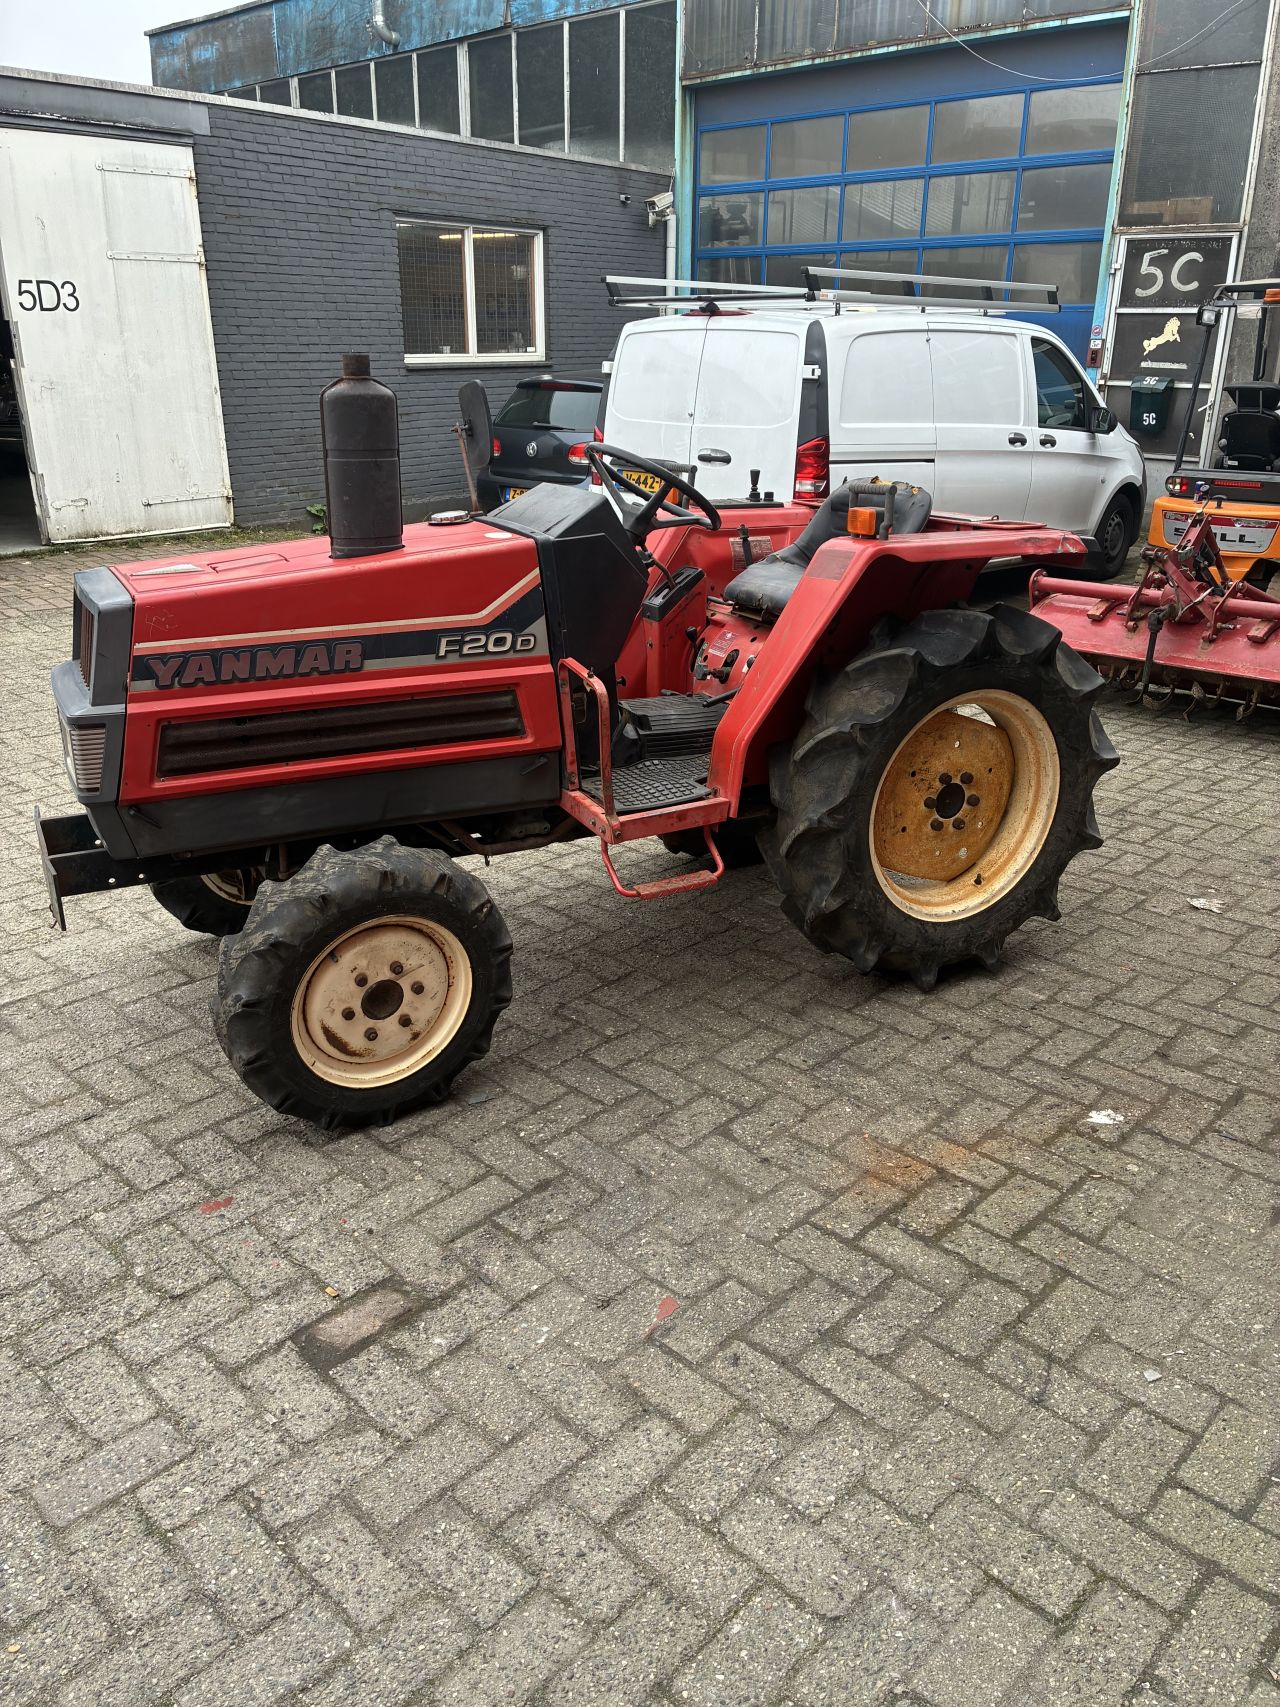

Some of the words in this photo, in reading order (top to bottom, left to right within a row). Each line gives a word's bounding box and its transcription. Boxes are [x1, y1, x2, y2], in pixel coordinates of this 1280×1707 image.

[1135, 248, 1203, 297] 5C
[18, 279, 80, 312] 5D3
[1143, 376, 1159, 385] 5C
[1142, 412, 1156, 425] 5C
[625, 473, 664, 489] V-442-
[147, 641, 364, 688] YANMAR
